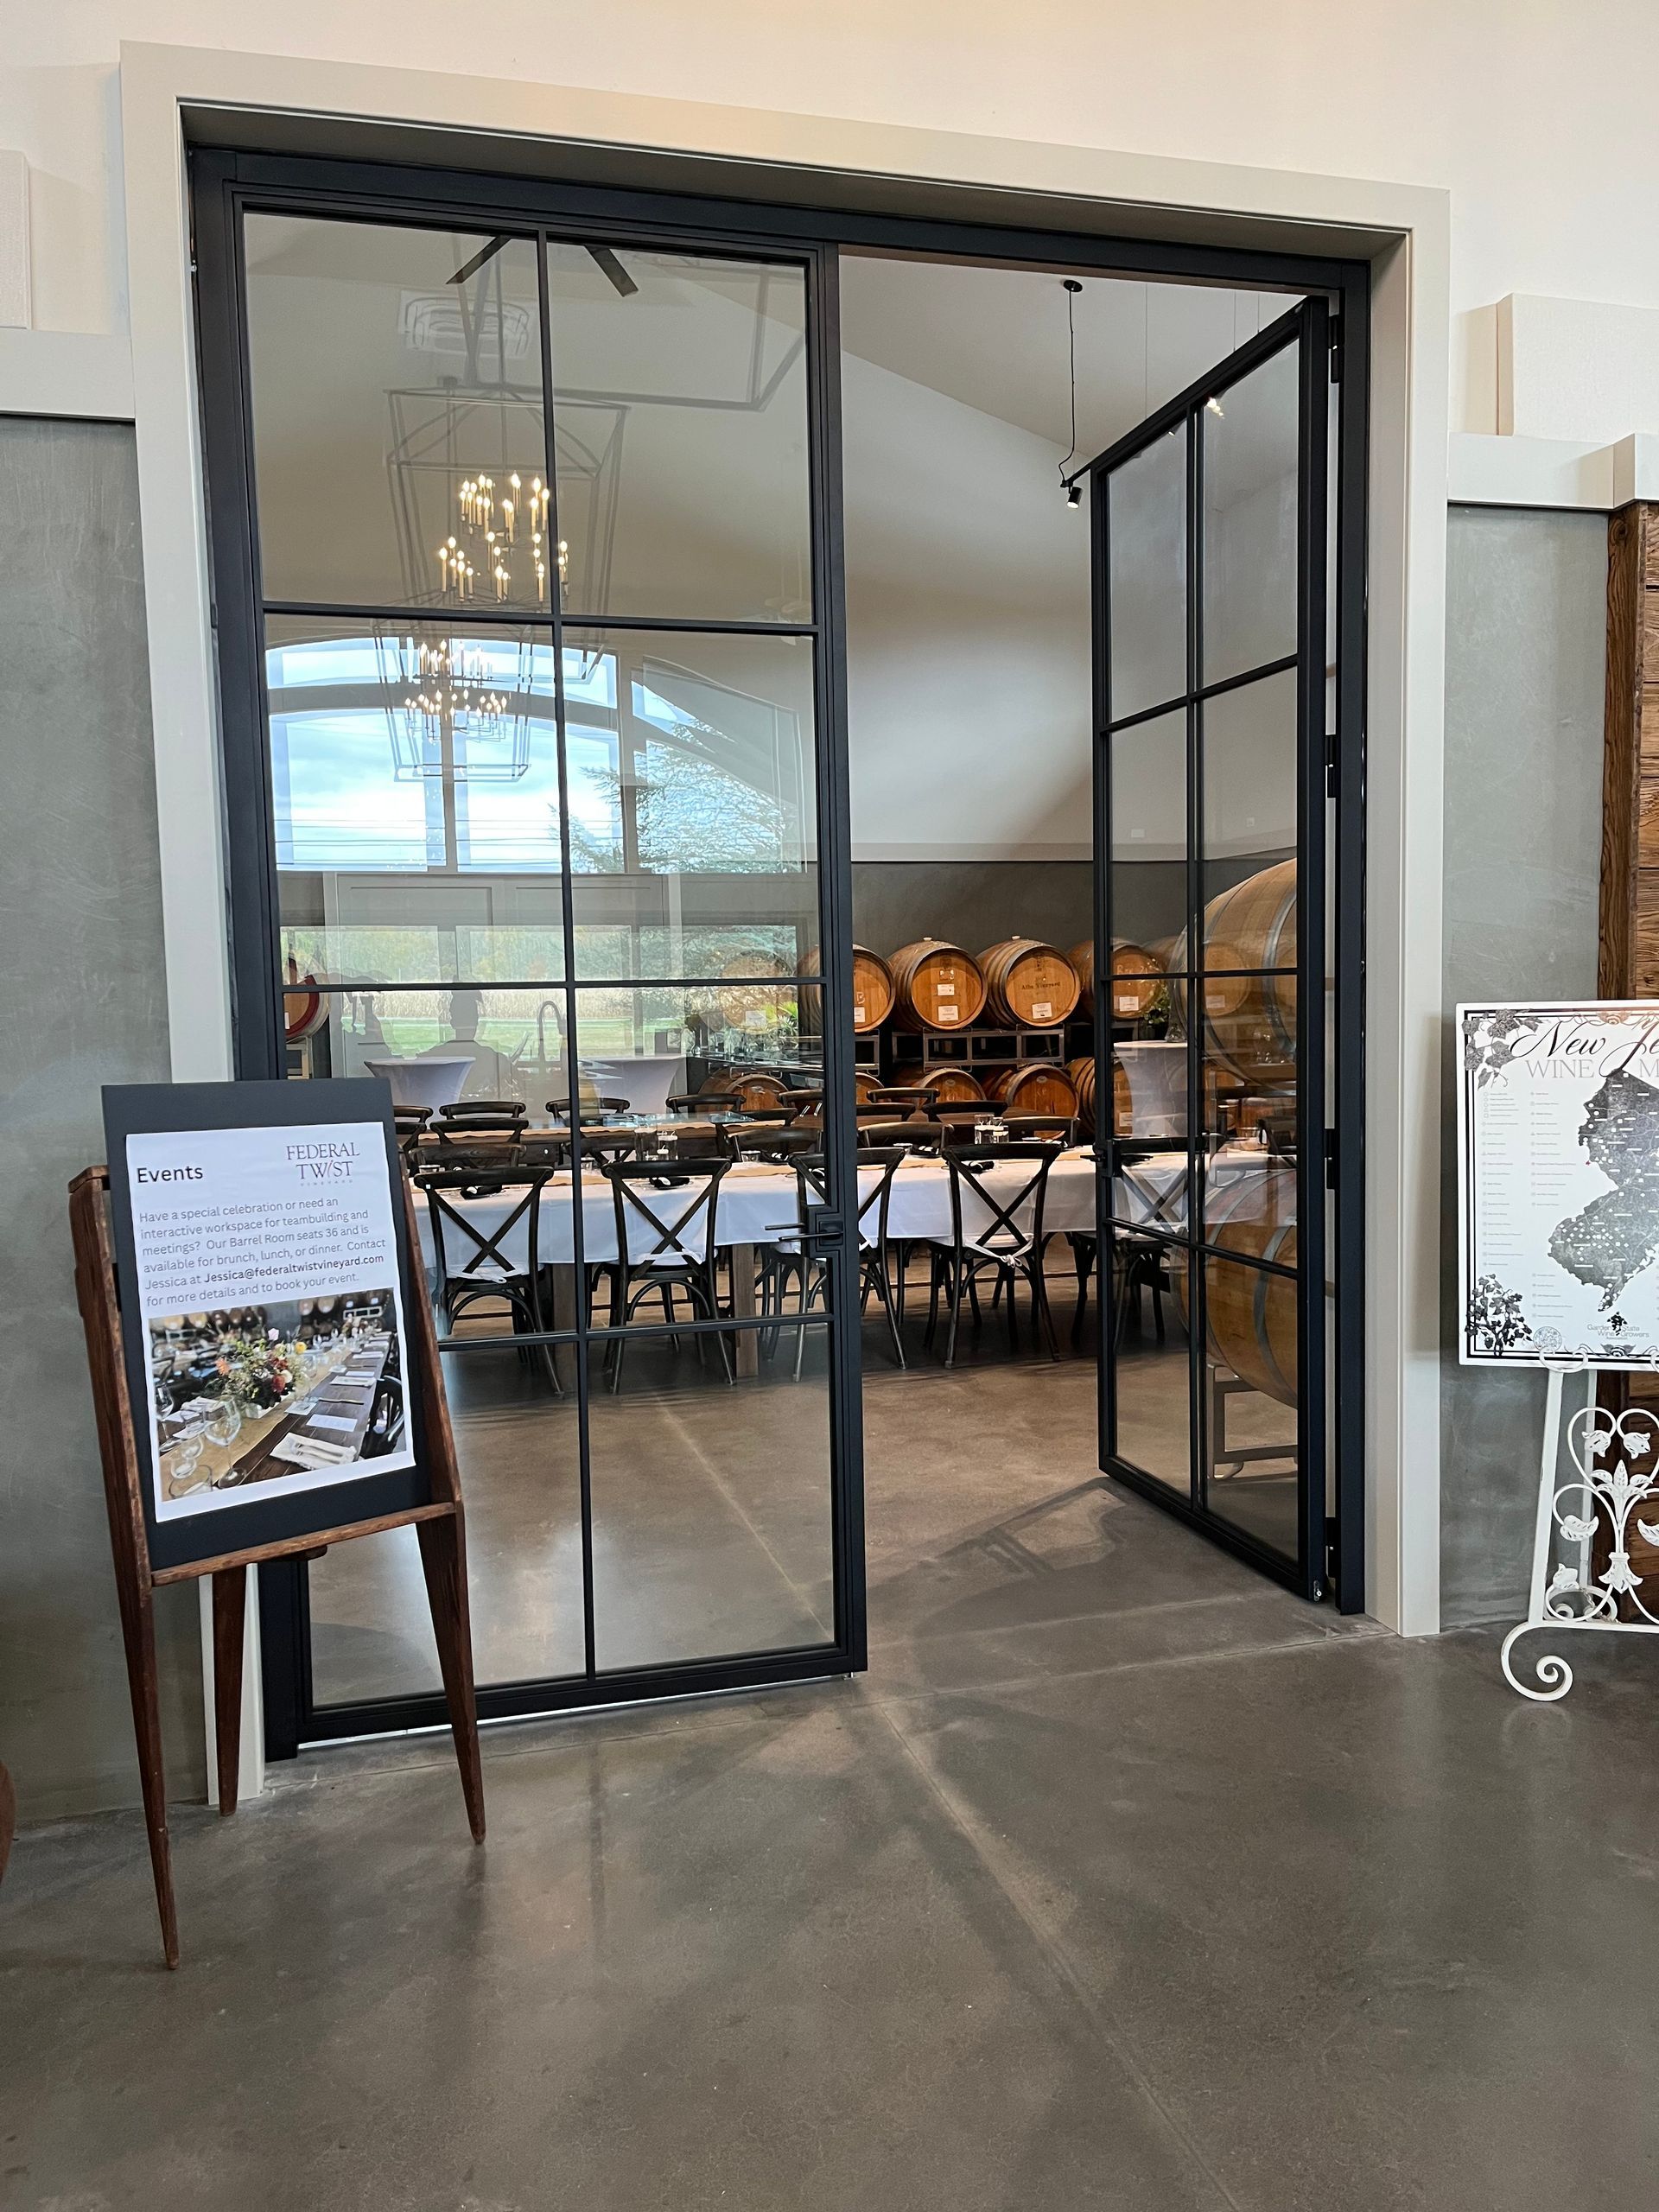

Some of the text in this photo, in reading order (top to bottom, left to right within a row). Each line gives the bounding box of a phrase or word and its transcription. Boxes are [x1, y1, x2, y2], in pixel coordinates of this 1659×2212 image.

[1510, 1013, 1659, 1077] New Je
[1525, 1058, 1594, 1078] WINE
[286, 1142, 360, 1160] FEDERAL
[137, 1166, 203, 1183] Events
[139, 1211, 168, 1222] Have
[181, 1206, 220, 1220] special
[222, 1202, 283, 1216] celebration
[299, 1198, 324, 1209] need
[141, 1210, 369, 1239] interactive workspace for teambuilding and
[143, 1224, 369, 1256] meetings? Our Barrel Room seats 36 and is
[143, 1239, 385, 1273] available for brunch, lunch, or dinner. Contact
[145, 1255, 384, 1290] Jessica at Jessica@federaltwistvineyard.com
[147, 1273, 359, 1306] for more details and to book your event.
